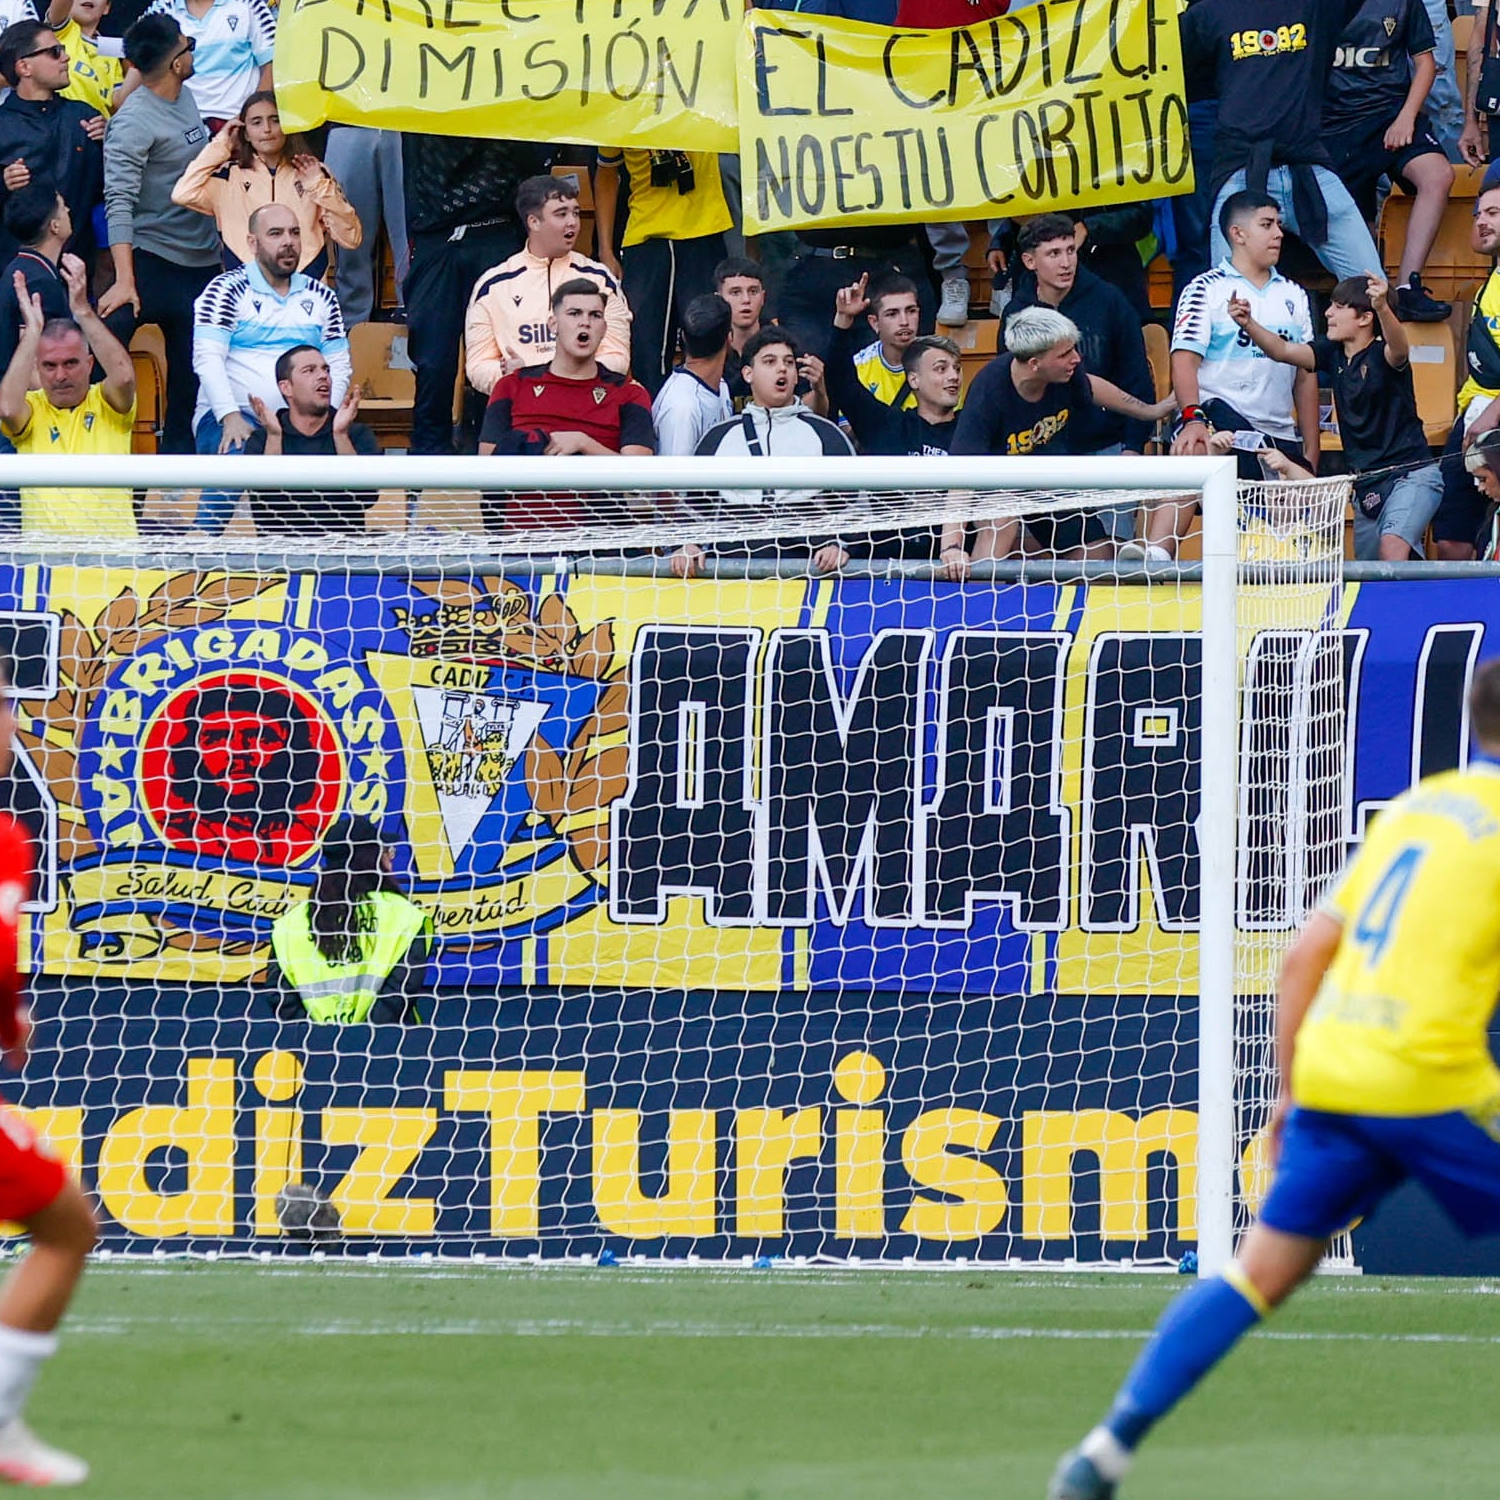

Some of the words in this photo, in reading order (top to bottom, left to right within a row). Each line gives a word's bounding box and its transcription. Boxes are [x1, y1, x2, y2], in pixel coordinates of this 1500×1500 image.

[317, 15, 705, 117] DIMISIÓN
[753, 25, 855, 118] EL
[974, 88, 1191, 205] CORTIJO
[518, 322, 558, 344] Silb
[105, 626, 386, 746] BRIGADAS
[429, 663, 494, 691] CADIZ
[116, 864, 214, 908] Salud,
[227, 879, 297, 916] Cadi
[1352, 843, 1426, 970] 4
